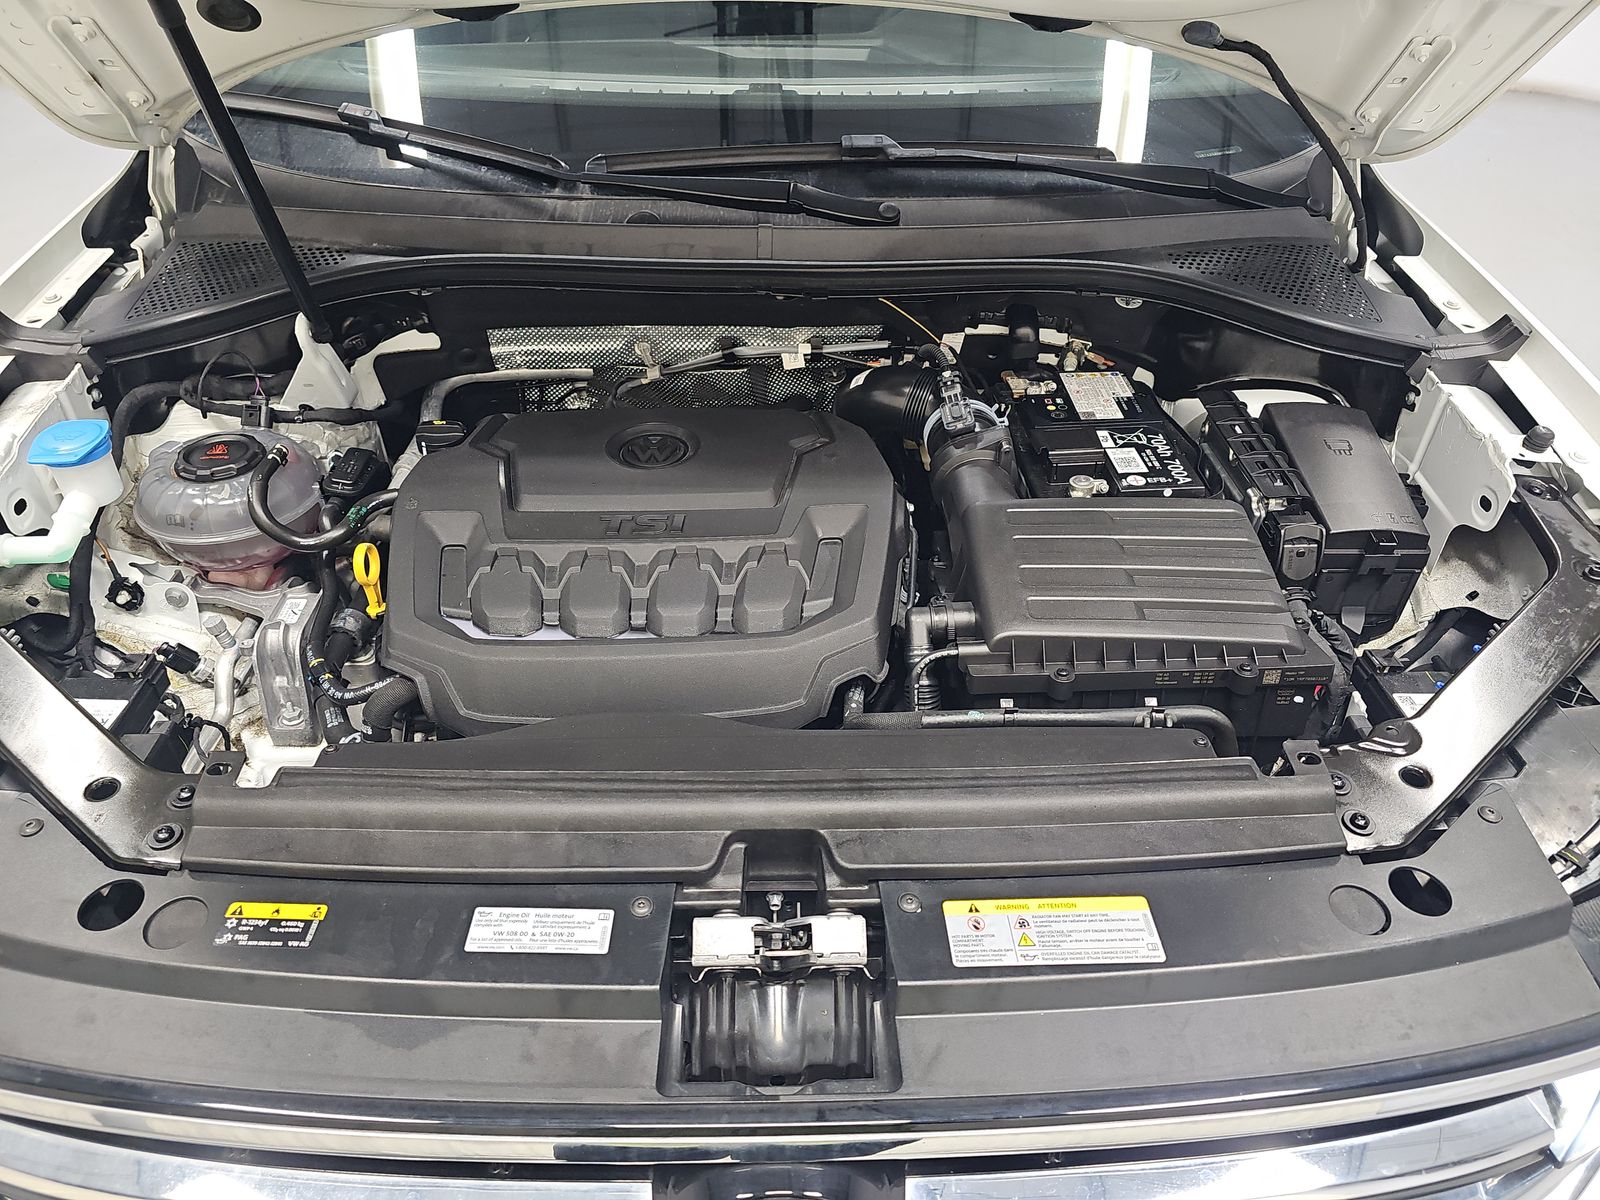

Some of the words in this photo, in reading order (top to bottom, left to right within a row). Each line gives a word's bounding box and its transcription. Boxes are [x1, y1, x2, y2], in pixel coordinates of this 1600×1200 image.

[1147, 433, 1173, 457] 70Ah
[1163, 458, 1192, 484] 700A
[600, 513, 687, 535] TSI
